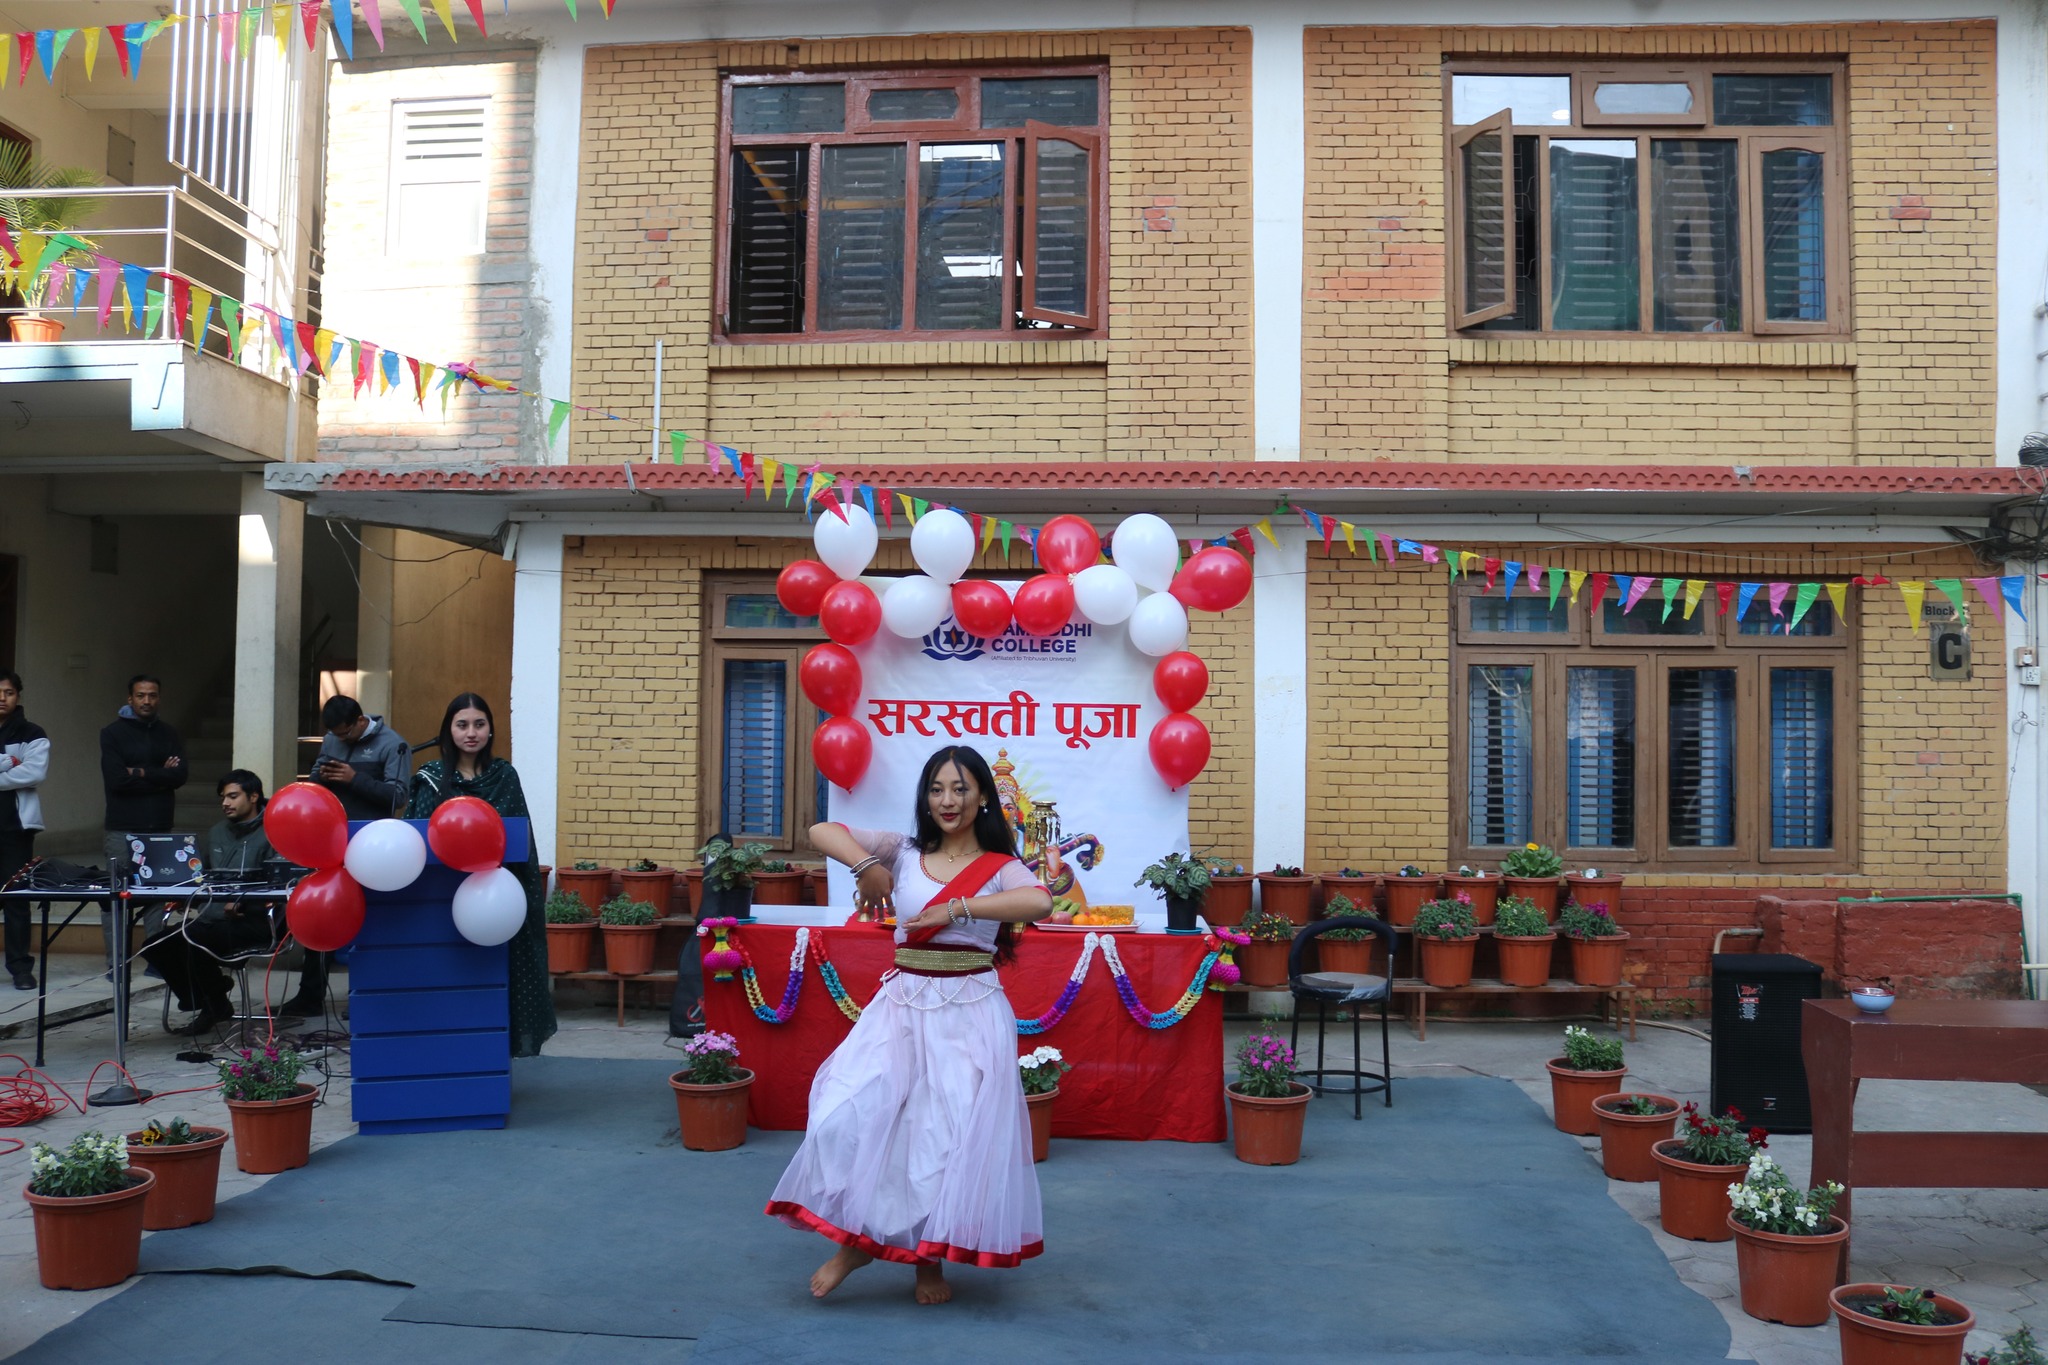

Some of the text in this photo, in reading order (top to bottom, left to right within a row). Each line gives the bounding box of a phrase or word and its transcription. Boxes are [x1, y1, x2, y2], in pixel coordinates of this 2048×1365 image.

[1925, 605, 1955, 616] Block
[991, 638, 1077, 653] COLLEGE
[1938, 632, 1962, 670] C
[868, 690, 1142, 750] सरस्वती पूजा
